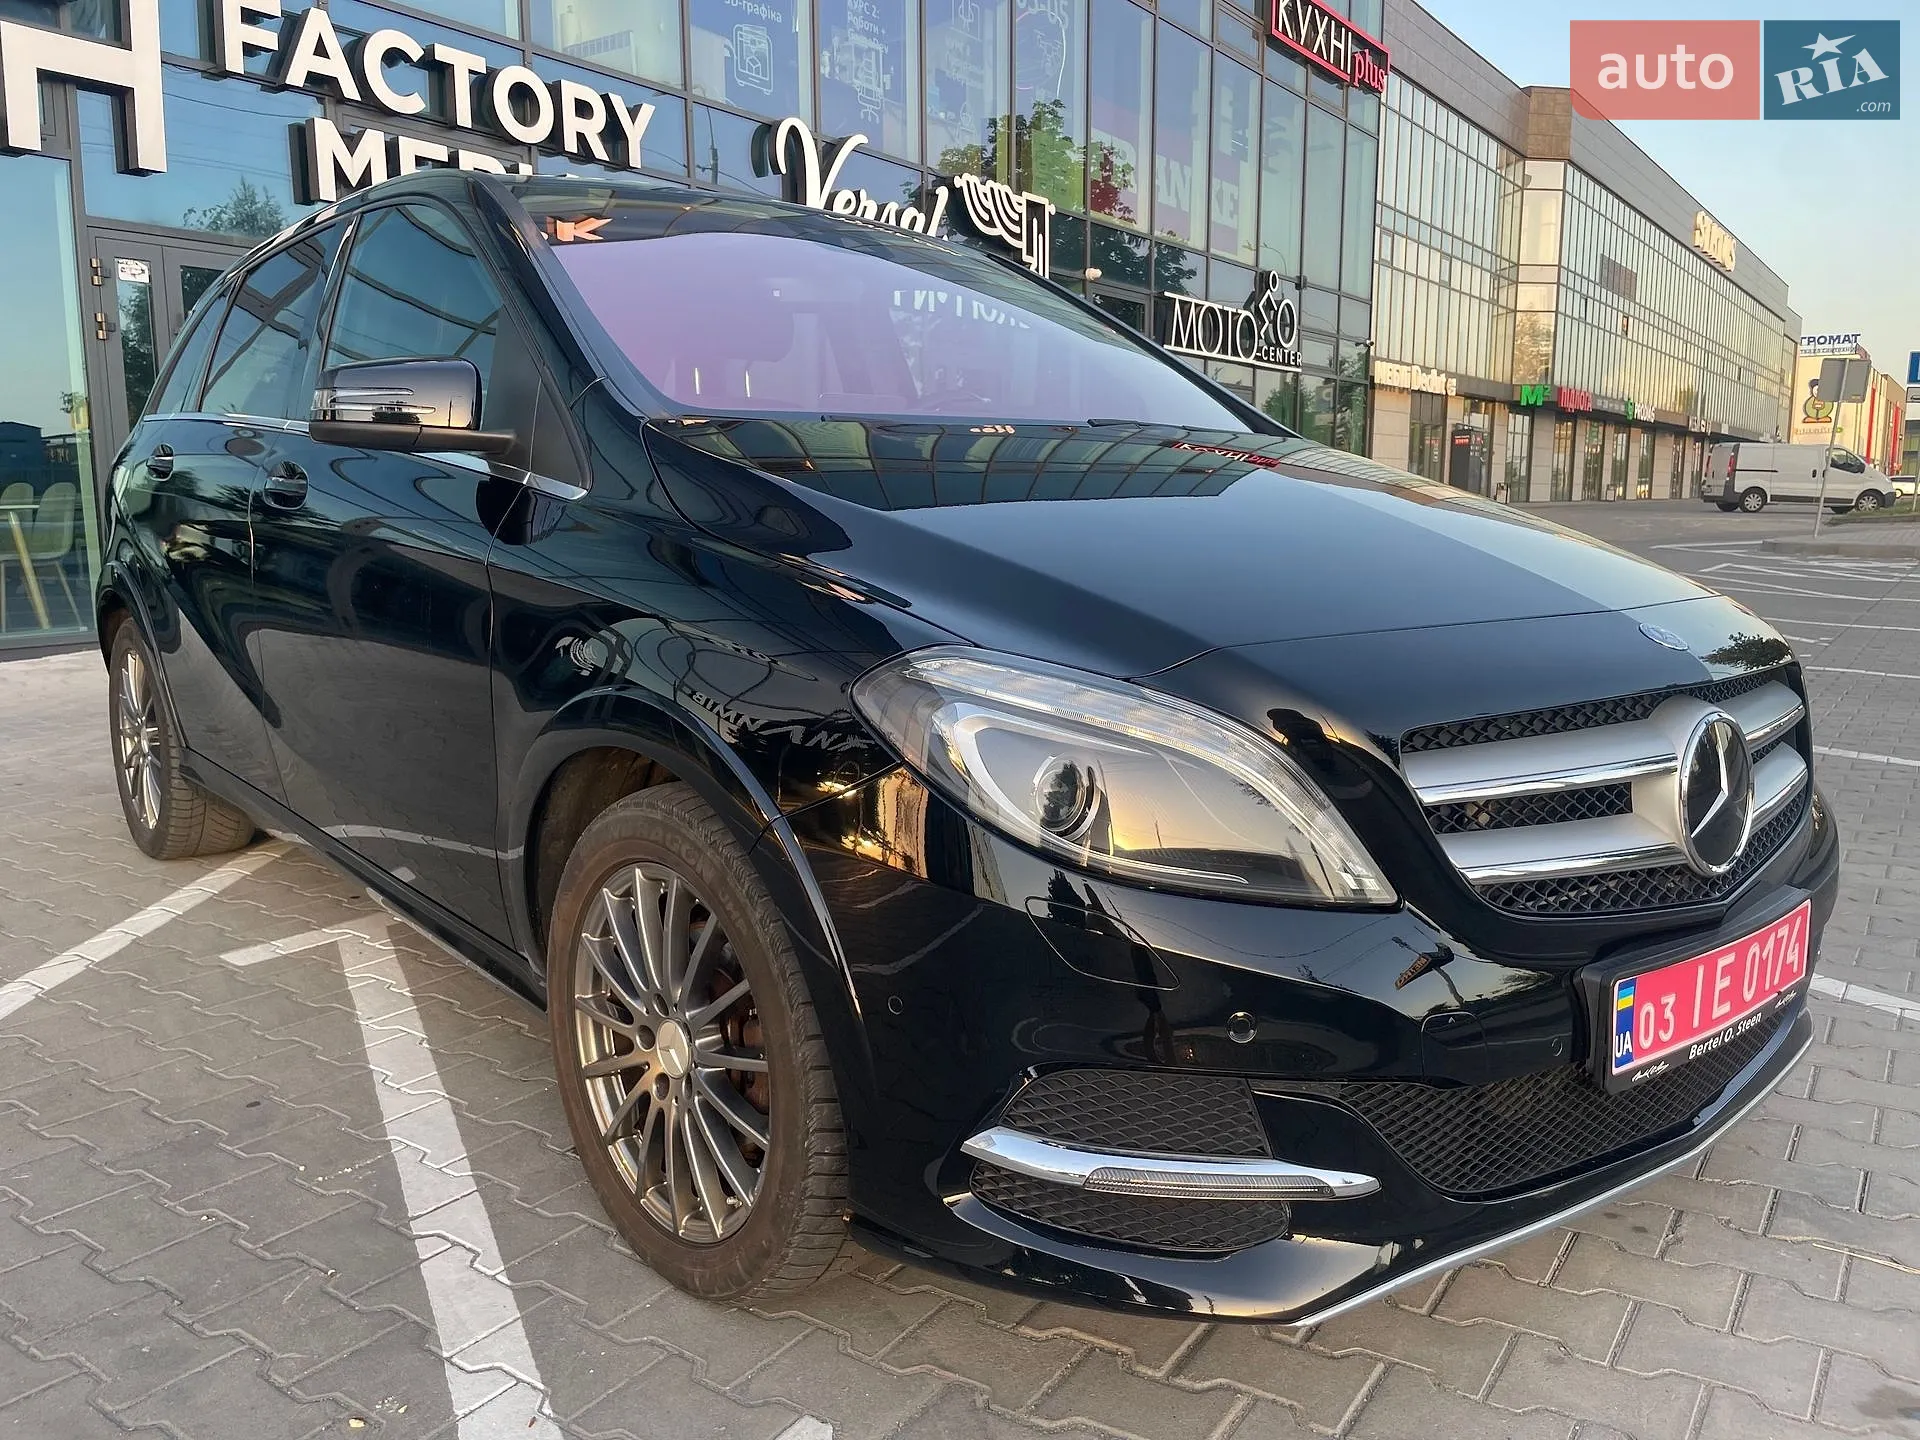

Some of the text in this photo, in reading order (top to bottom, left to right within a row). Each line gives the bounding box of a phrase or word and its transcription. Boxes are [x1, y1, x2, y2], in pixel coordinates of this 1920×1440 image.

[223, 0, 655, 169] FACTORY
[1353, 48, 1386, 93] plus
[1163, 291, 1259, 361] MOTO
[1639, 993, 1677, 1050] 03
[1742, 915, 1802, 1002] 0174
[1614, 1031, 1633, 1057] UA
[1688, 1012, 1762, 1060] Bertel O. Steen
